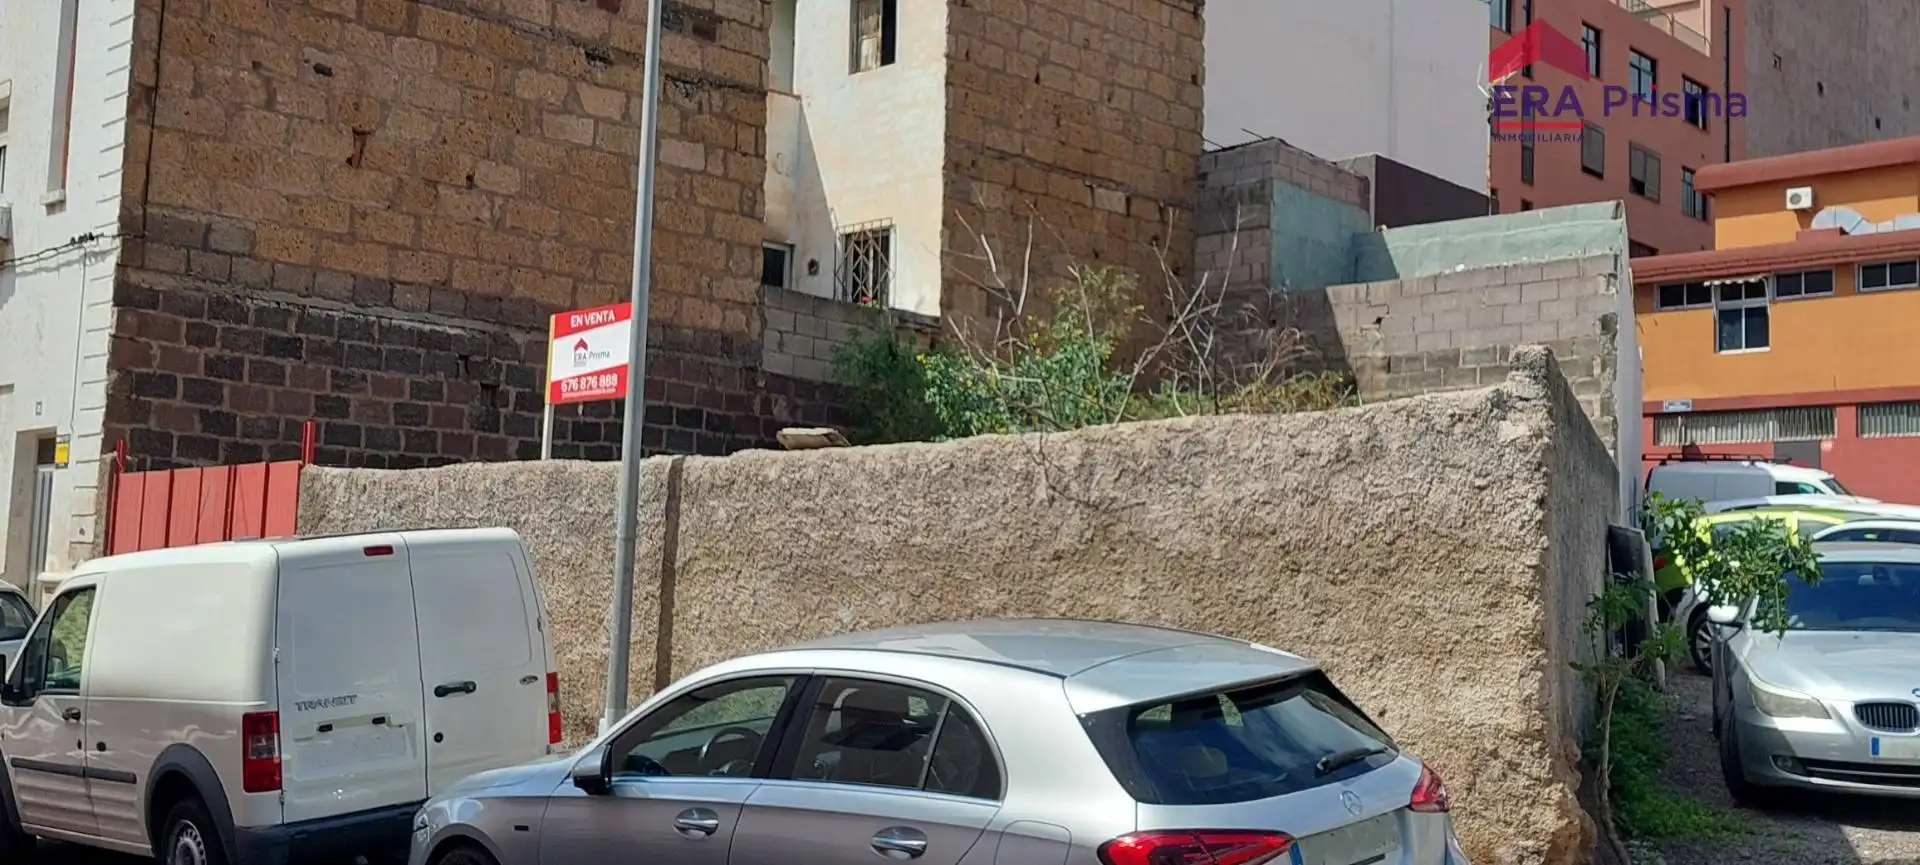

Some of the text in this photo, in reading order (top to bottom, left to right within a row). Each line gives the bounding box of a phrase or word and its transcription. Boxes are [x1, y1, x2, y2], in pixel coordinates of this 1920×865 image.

[570, 309, 616, 328] EN VENTA
[561, 372, 618, 393] 676 876 888
